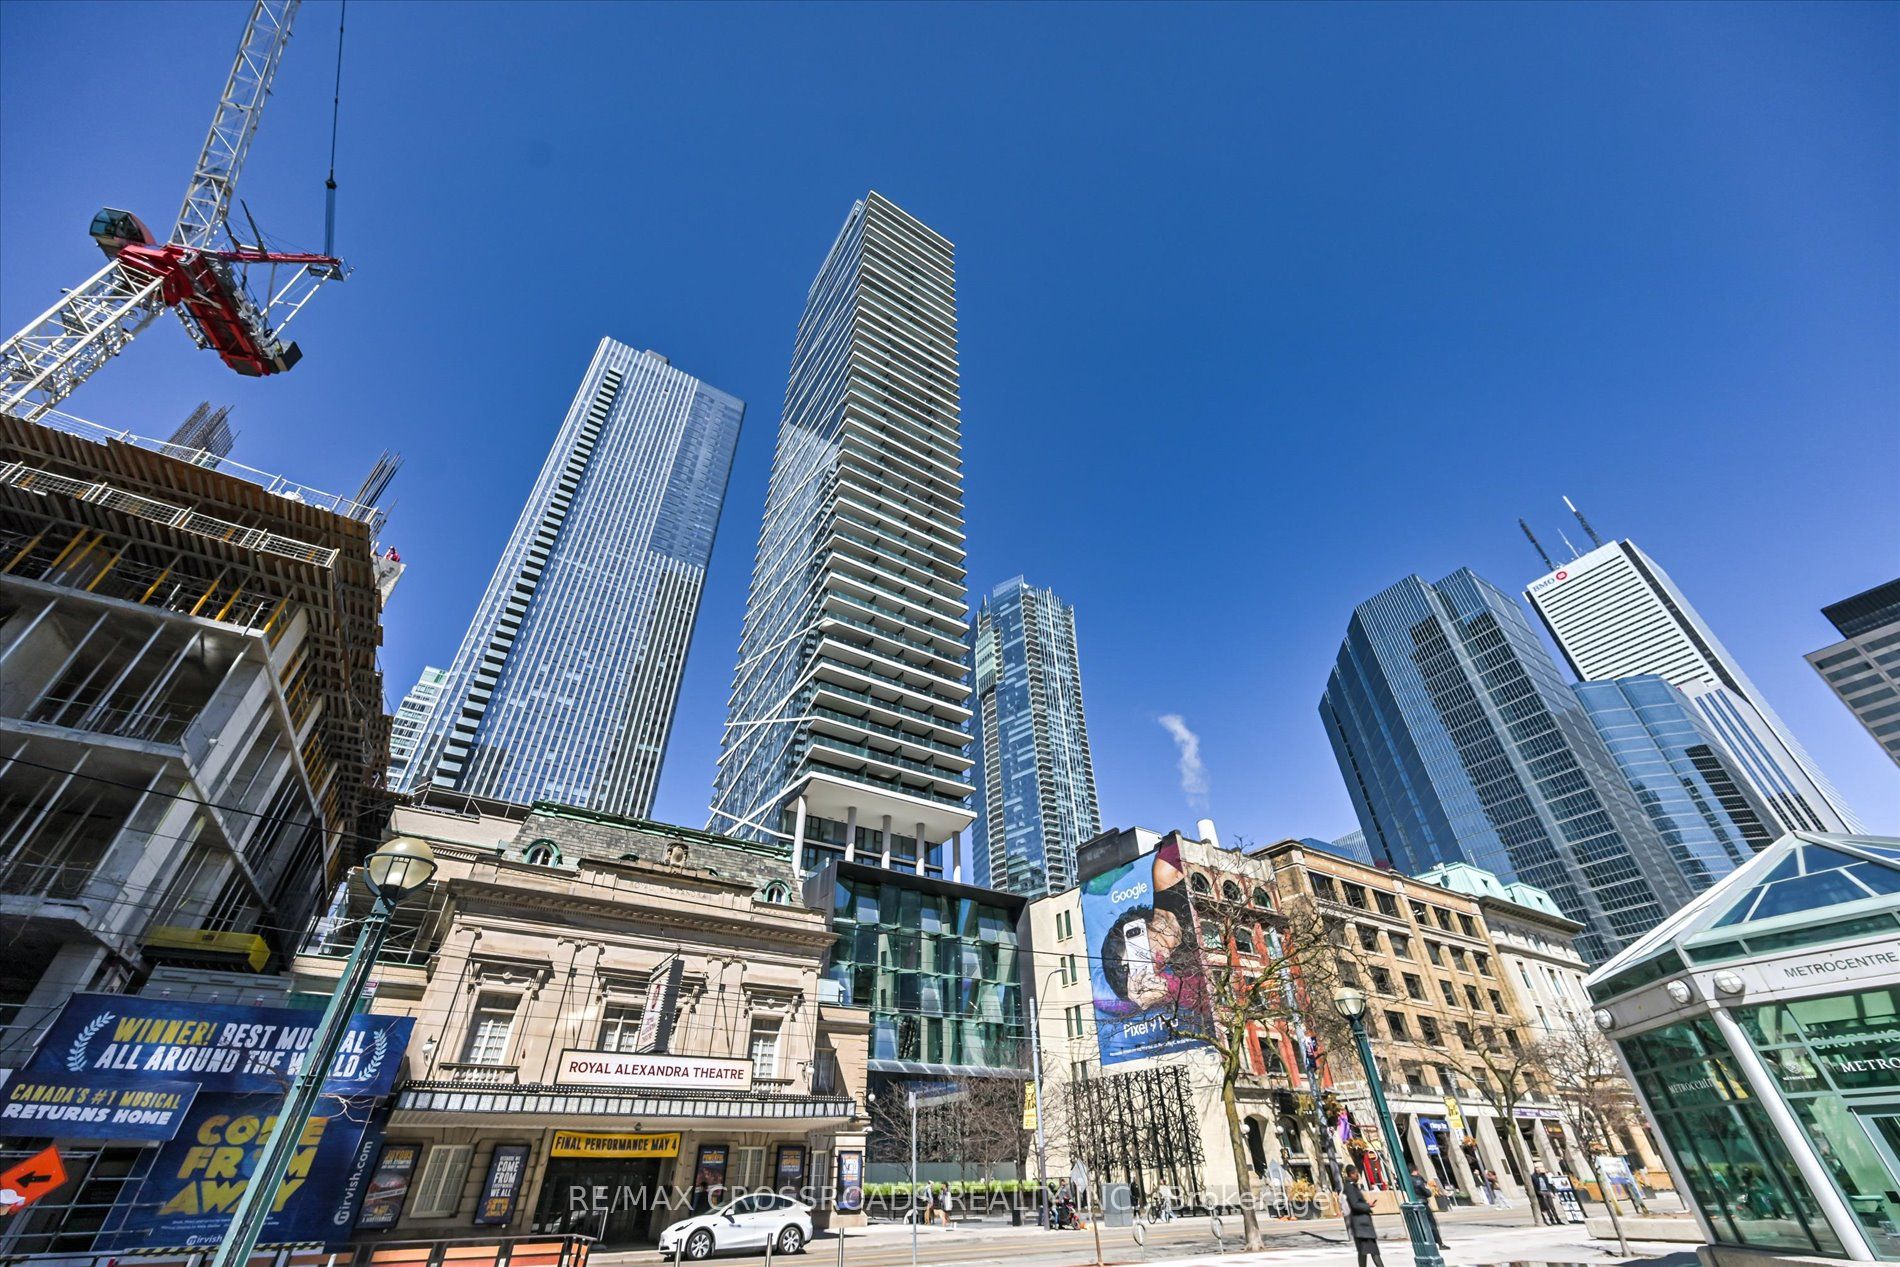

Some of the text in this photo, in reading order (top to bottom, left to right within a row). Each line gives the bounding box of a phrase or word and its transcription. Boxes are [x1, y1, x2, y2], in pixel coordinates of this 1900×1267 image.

[1533, 578, 1555, 592] BMO
[1111, 882, 1148, 903] Google
[1784, 953, 1899, 977] METROCENTRE
[112, 1016, 366, 1053] WINNER! BEST MUAL
[1123, 1020, 1149, 1039] Pixel
[94, 1043, 360, 1078] ALL AROUND THE WLD
[568, 1060, 745, 1080] ROYAL ALEXANDRA THEATRE
[10, 1083, 182, 1110] CANADA'S #1 MUSICAL
[1, 1102, 174, 1126] RETURNS HOME
[555, 1136, 678, 1151] FINAL PERFORMANCE MAY 4
[496, 1161, 520, 1172] COME
[493, 1172, 517, 1184] FROM
[157, 1178, 307, 1216] AWY
[490, 1189, 511, 1197] WE ALL
